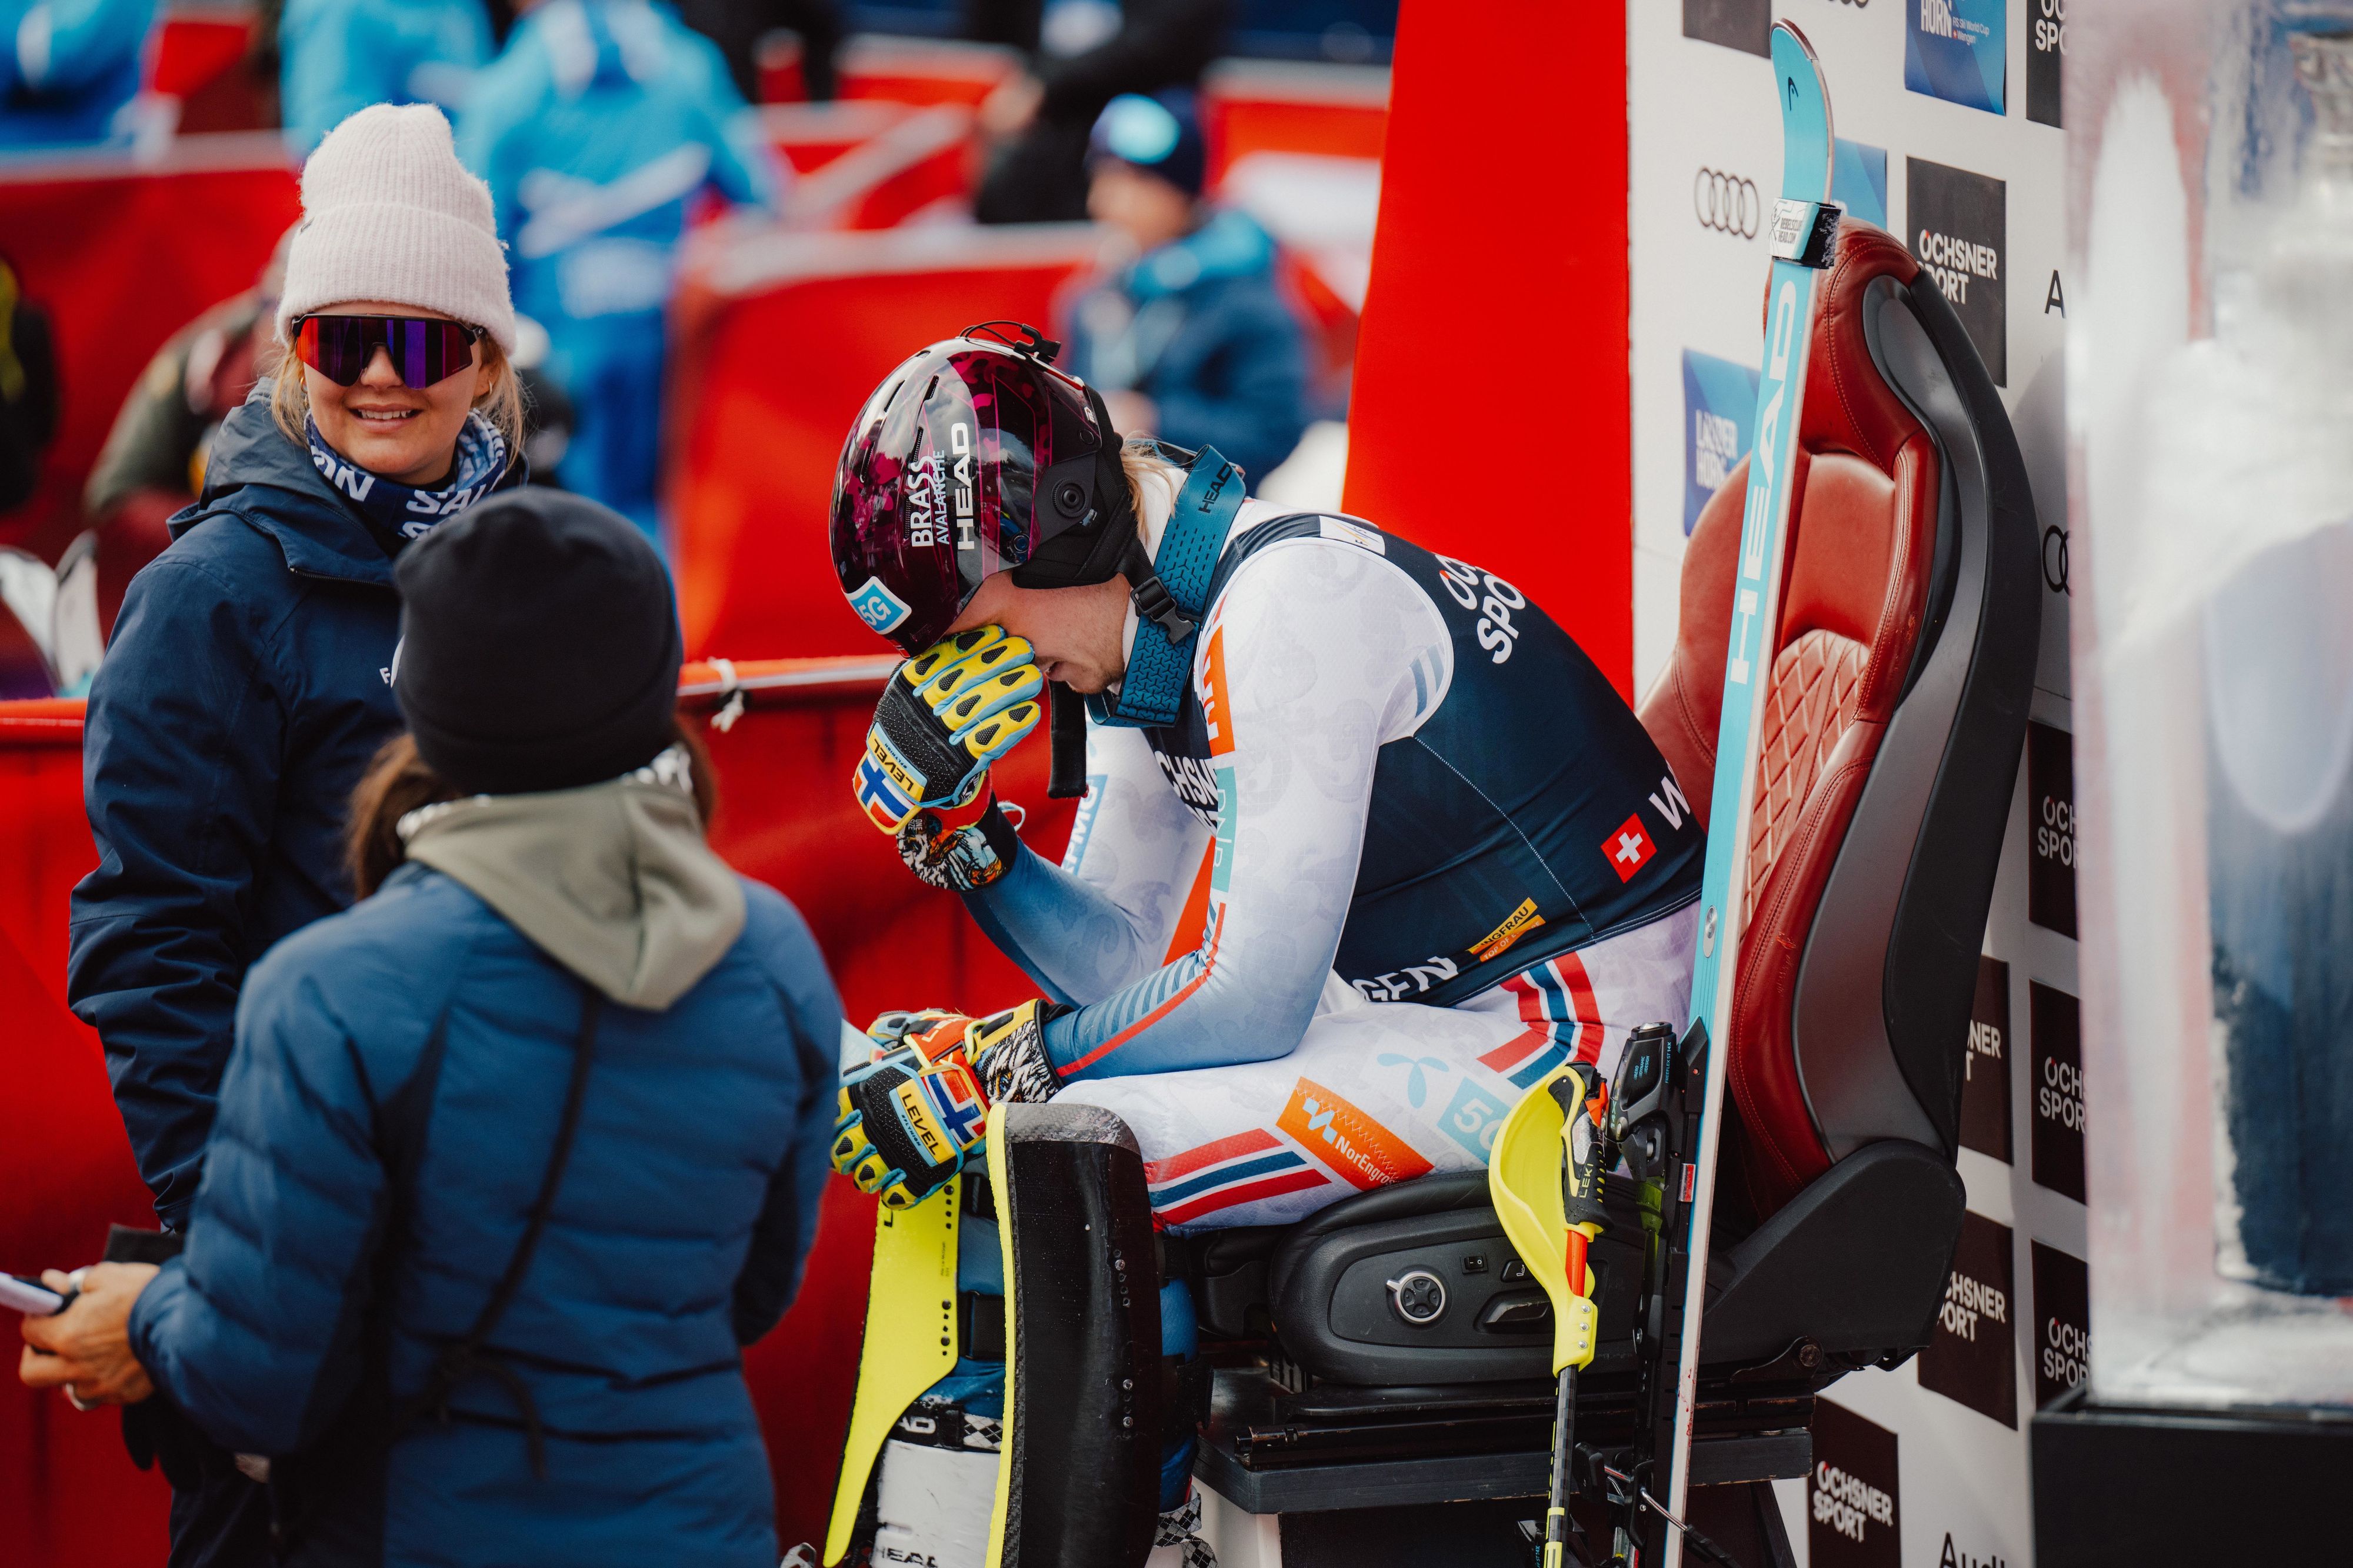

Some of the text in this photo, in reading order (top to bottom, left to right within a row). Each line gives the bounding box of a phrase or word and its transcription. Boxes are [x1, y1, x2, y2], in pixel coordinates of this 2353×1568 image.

[1919, 229, 1997, 280] OCHSNER
[908, 455, 937, 547] BRASS
[951, 422, 975, 550] HEAD
[1198, 462, 1233, 514] HEAD
[1731, 281, 1797, 685] HEAD
[858, 596, 891, 626] 5G
[874, 738, 914, 792] LEVEL
[1484, 937, 1509, 959] TOP OF
[902, 1093, 939, 1155] LEVEL
[1579, 1163, 1594, 1198] LEKI
[1814, 1490, 1867, 1543] SPORT
[1817, 1460, 1894, 1527] OCHSNER
